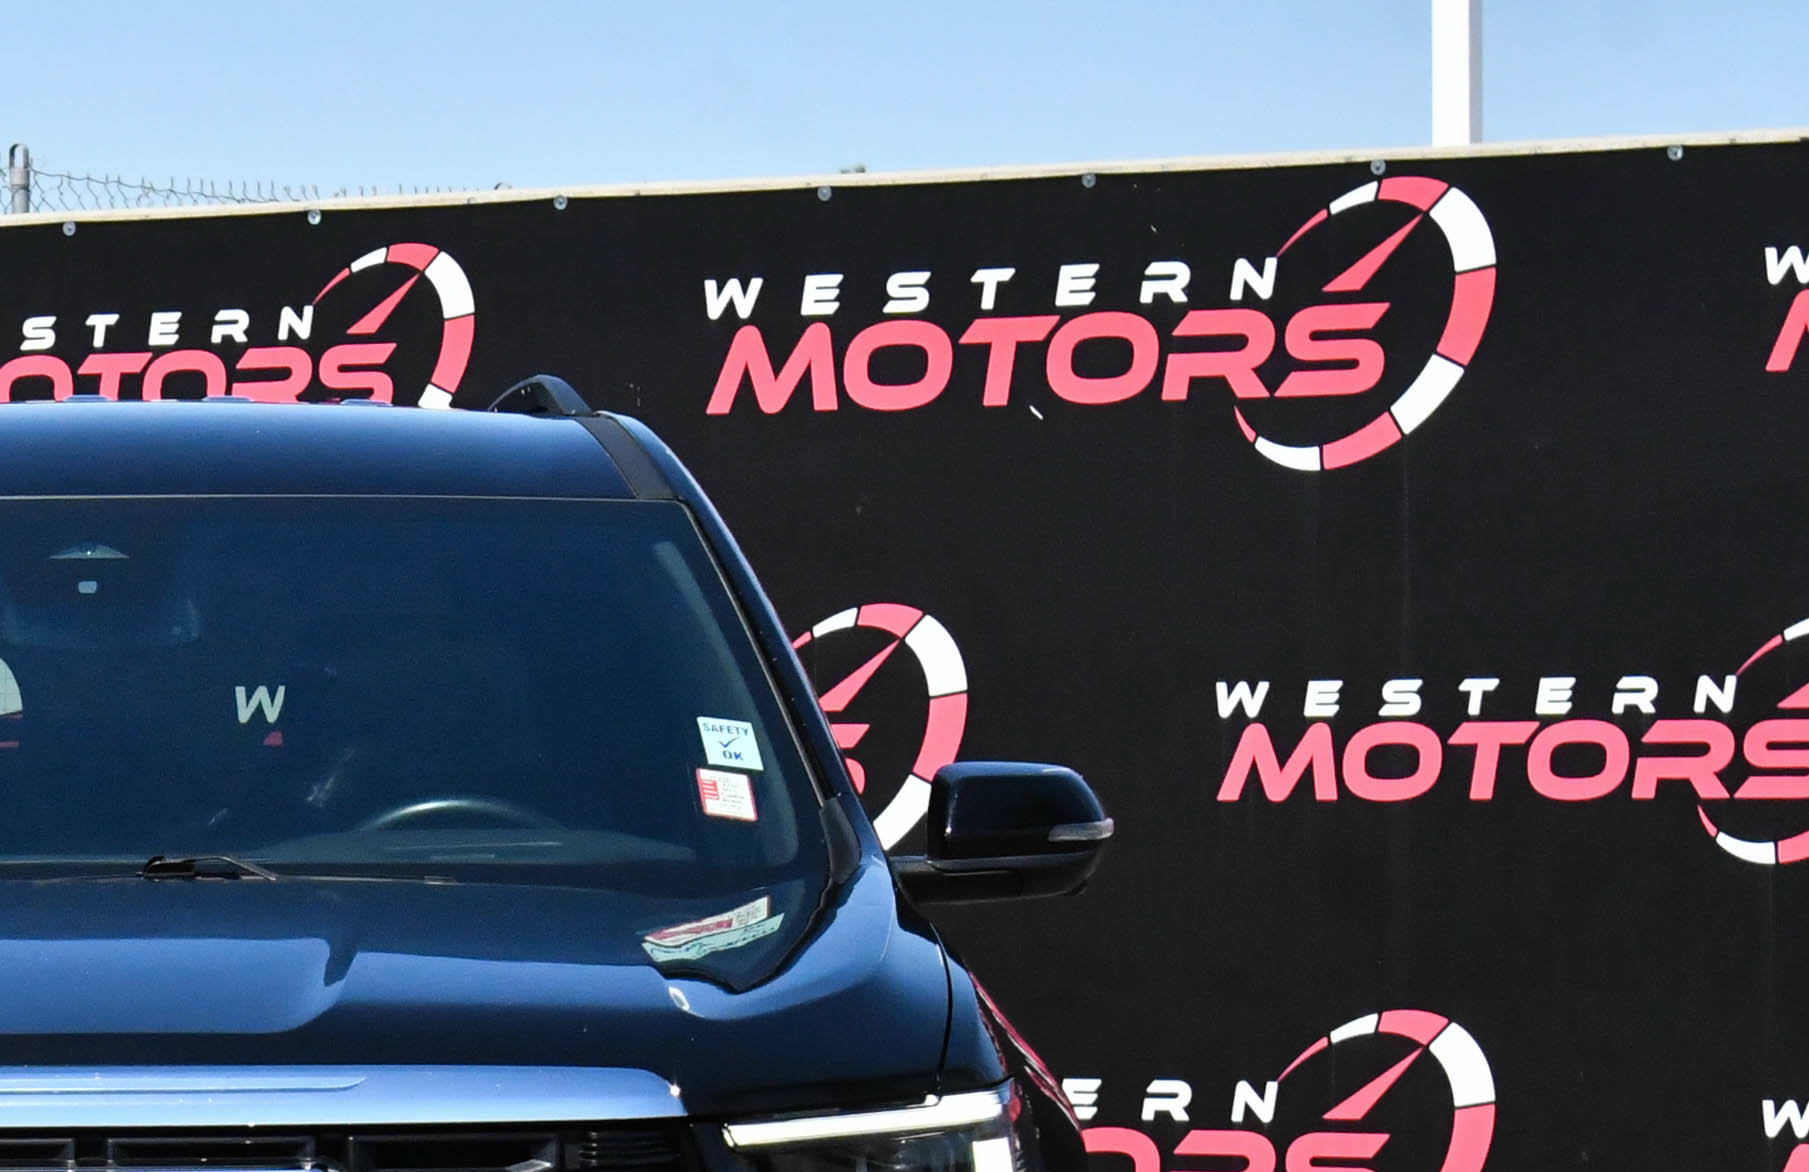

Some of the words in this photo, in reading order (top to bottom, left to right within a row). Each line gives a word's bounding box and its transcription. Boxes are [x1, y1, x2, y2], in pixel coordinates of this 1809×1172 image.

[704, 256, 1277, 320] WESTERN
[706, 302, 1390, 415] MOTORS
[1216, 674, 1737, 719] WESTERN
[702, 722, 749, 737] SAFETY
[722, 750, 745, 761] OK
[1217, 718, 1809, 801] MOTORS
